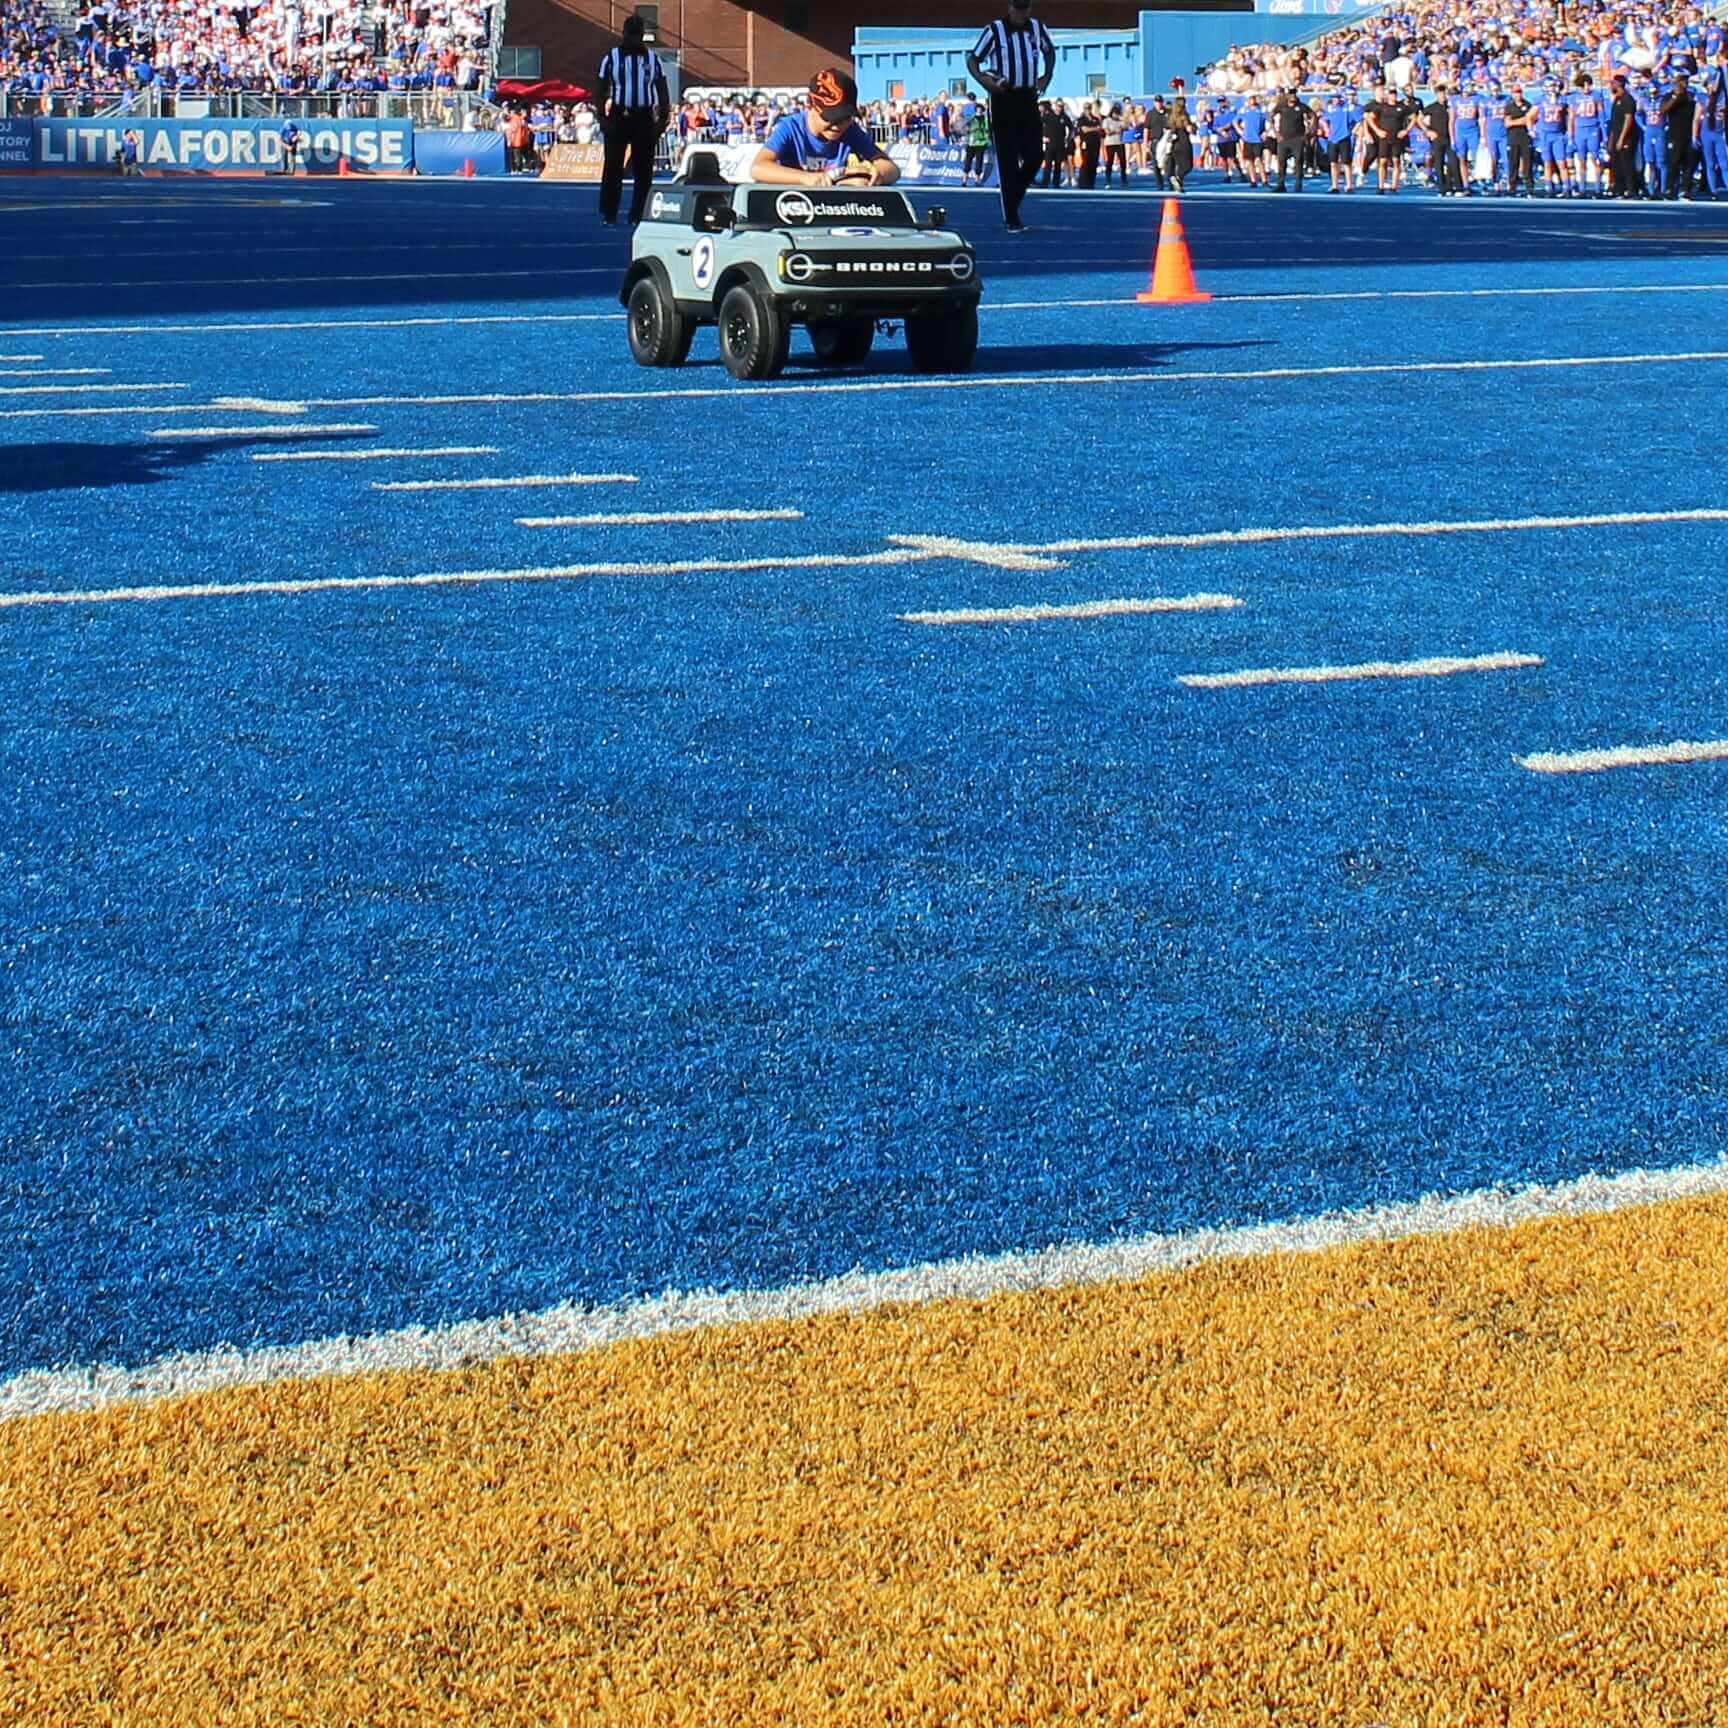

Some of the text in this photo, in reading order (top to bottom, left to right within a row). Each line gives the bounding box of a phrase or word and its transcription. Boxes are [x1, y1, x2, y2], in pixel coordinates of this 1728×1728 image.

[1576, 101, 1595, 117] 40
[813, 202, 885, 217] classifieds
[696, 244, 710, 278] 2
[836, 262, 932, 272] BRONCO
